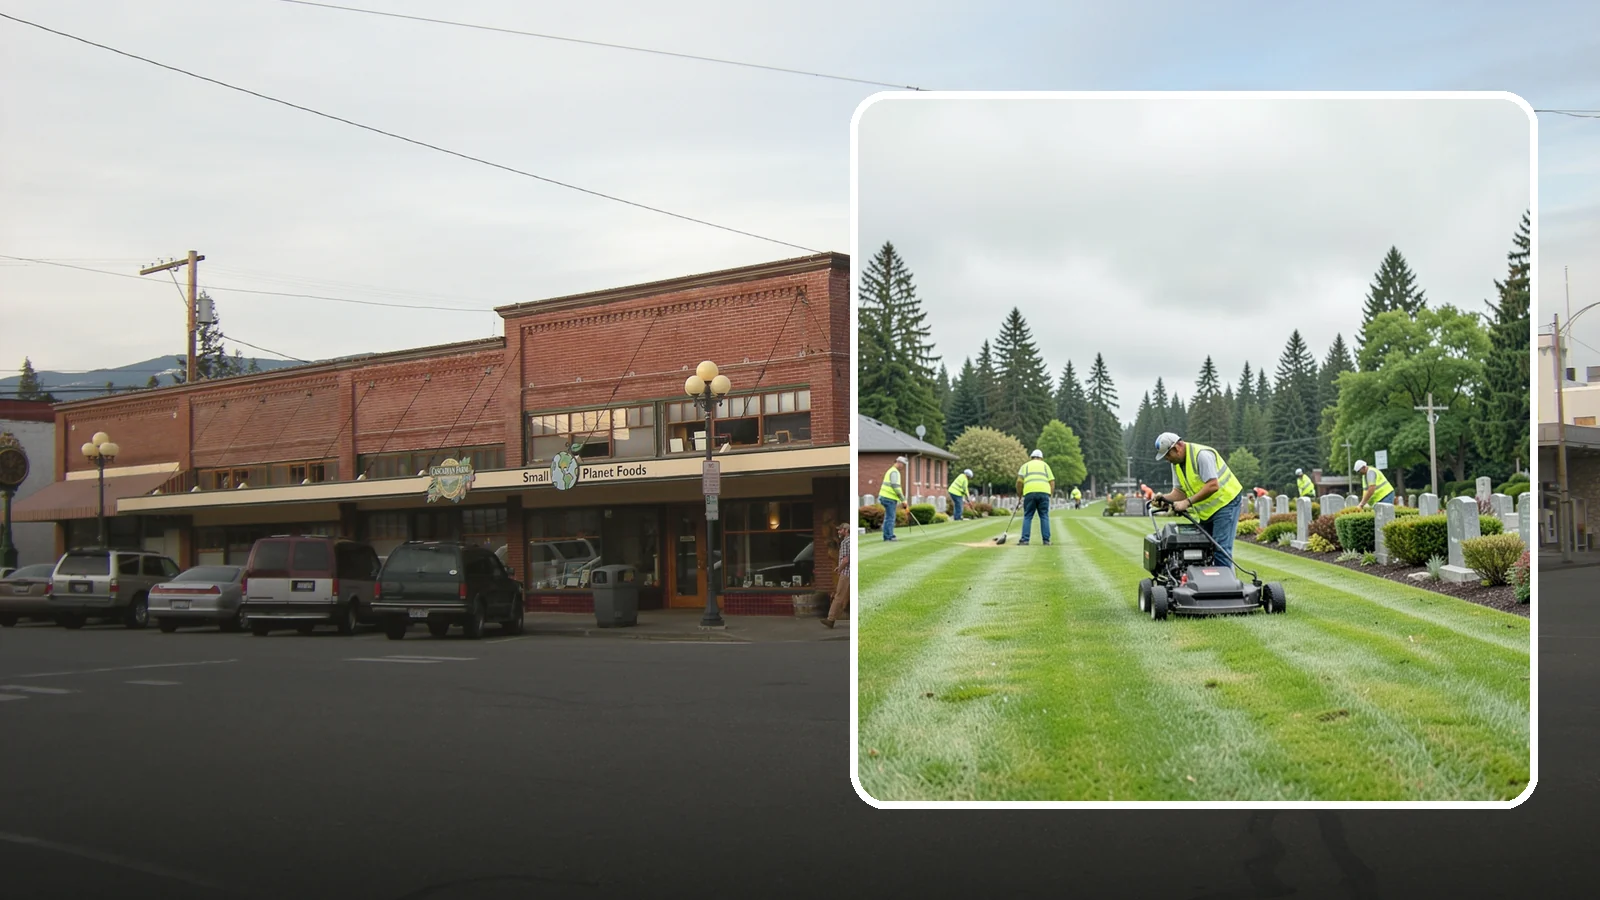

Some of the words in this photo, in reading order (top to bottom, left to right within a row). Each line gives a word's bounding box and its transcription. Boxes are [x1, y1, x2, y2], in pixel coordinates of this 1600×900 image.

[523, 471, 549, 483] Small
[582, 467, 614, 480] Planet
[616, 464, 647, 477] Foods
